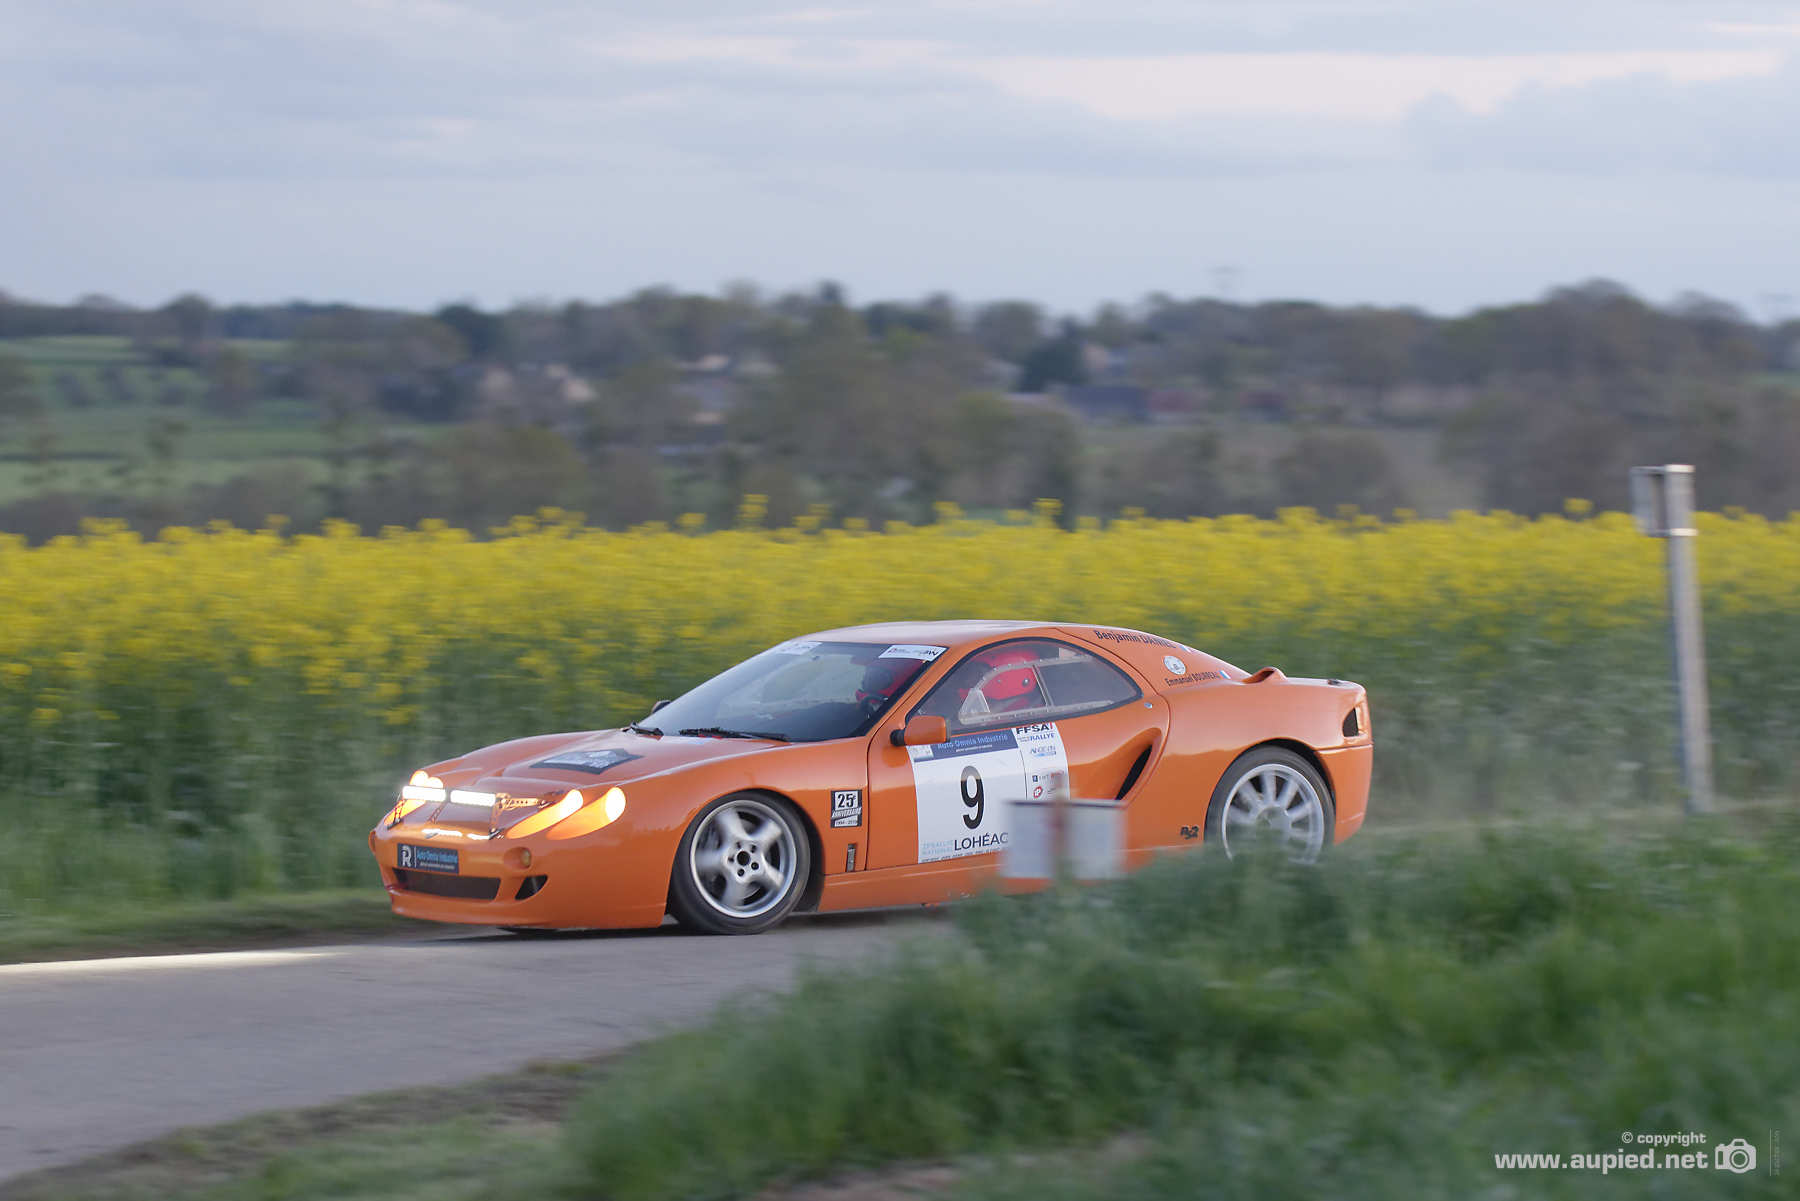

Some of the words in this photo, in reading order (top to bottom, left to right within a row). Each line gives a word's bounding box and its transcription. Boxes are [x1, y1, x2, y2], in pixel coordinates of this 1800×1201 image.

[1094, 630, 1139, 643] Benjamin
[1016, 723, 1050, 734] FFSA
[1030, 733, 1055, 741] RALLYE
[960, 765, 985, 830] 9
[954, 832, 1008, 851] LOHÉAC
